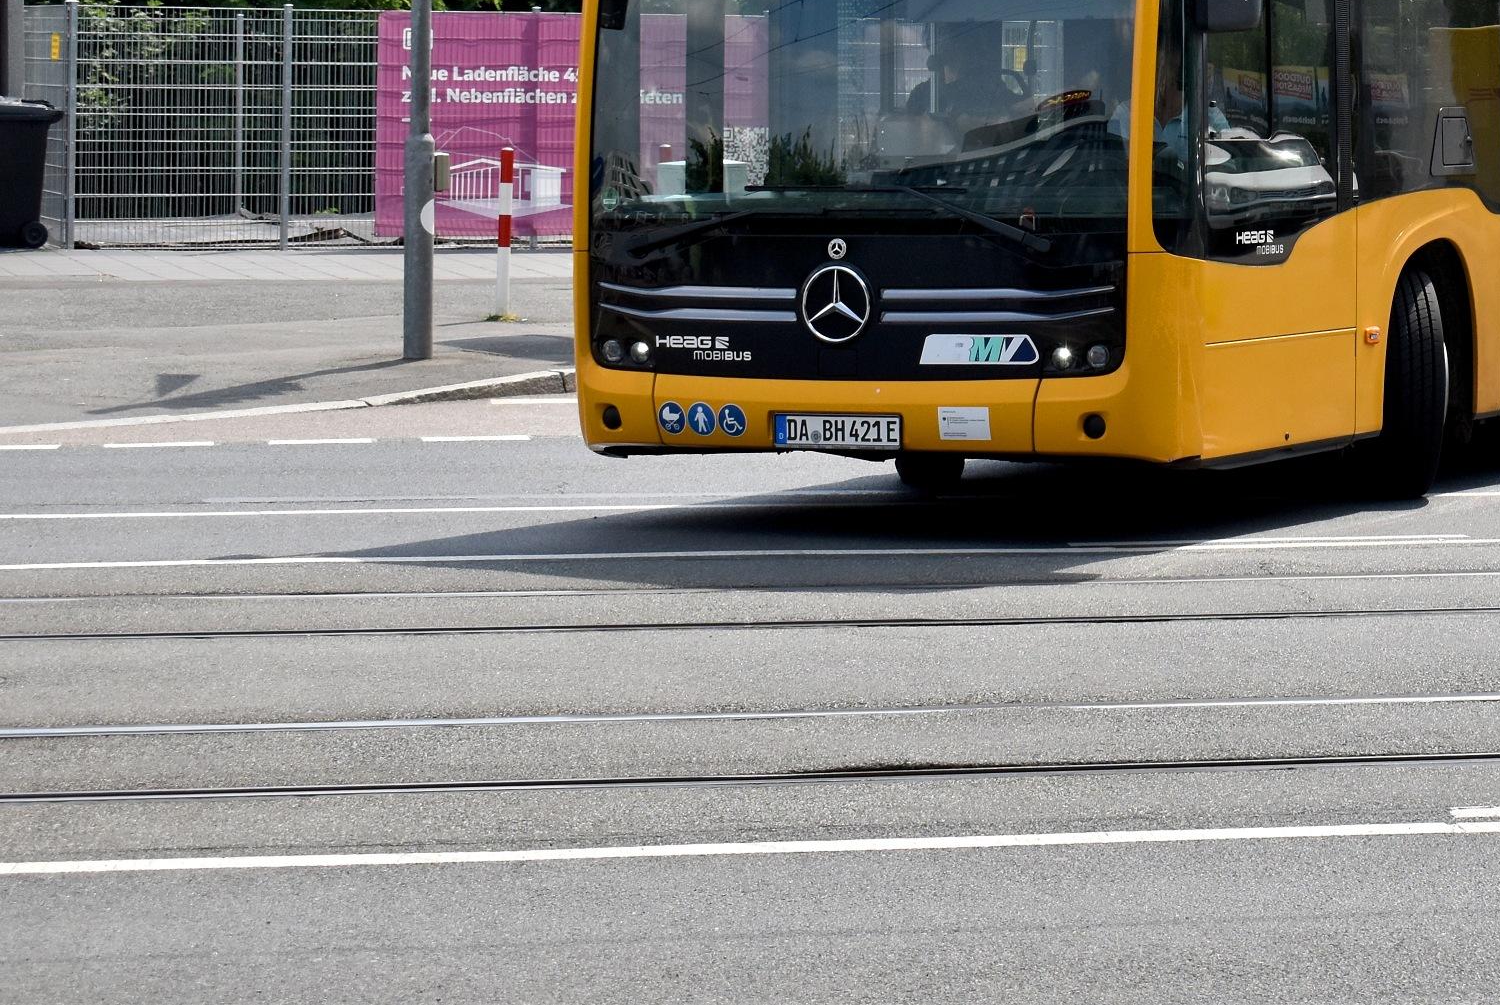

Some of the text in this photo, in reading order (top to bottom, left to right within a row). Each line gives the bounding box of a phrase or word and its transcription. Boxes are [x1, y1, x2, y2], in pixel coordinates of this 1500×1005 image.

[402, 66, 448, 82] Nue
[453, 66, 560, 82] Ladenfläche
[402, 87, 442, 103] zl.
[446, 88, 567, 103] Nebenflächen
[693, 350, 752, 361] MOBIBUS
[786, 419, 809, 442] DA
[822, 420, 845, 442] BH
